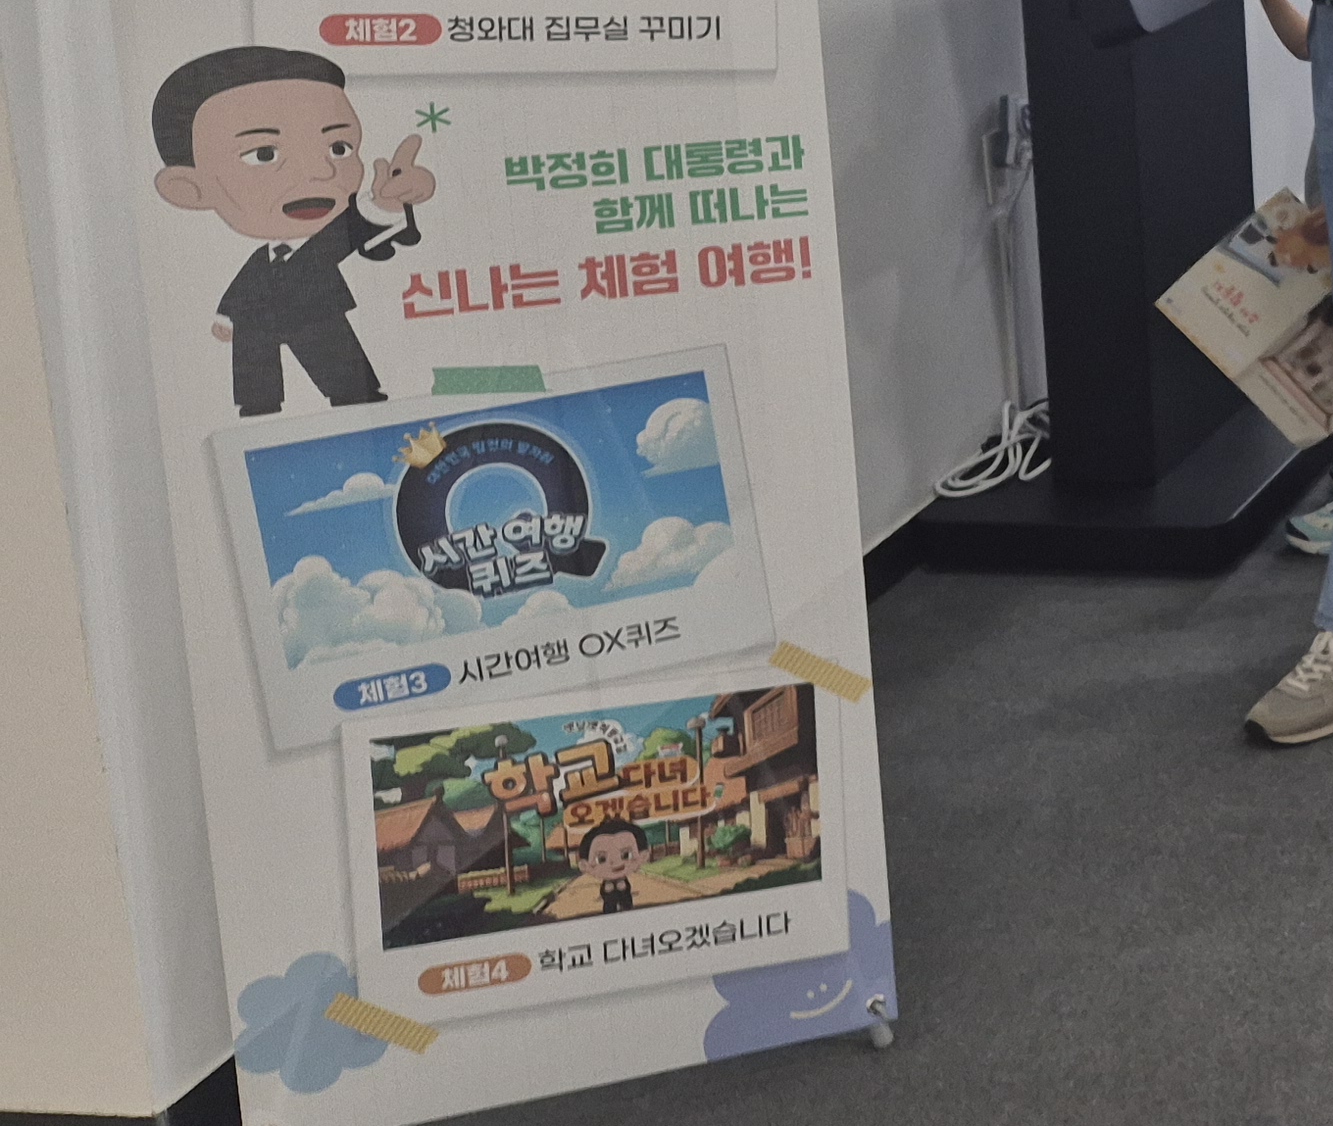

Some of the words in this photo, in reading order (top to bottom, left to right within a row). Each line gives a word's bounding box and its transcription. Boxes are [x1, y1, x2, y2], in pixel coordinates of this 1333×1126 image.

[345, 17, 418, 43] 체험2
[447, 15, 535, 43] 청와대
[544, 15, 630, 42] 집무실
[638, 16, 722, 42] 꾸미기
[504, 147, 630, 191] 박정희
[643, 134, 805, 182] 대통령과
[593, 192, 676, 235] 함께
[689, 183, 810, 226] 떠나는
[402, 262, 562, 320] 신나는
[578, 249, 680, 301] 체험
[698, 235, 812, 289] 여행!
[419, 522, 498, 574] 시간
[501, 514, 588, 554] 여행
[468, 550, 554, 597] 퀴즈
[357, 670, 428, 705] 체험3
[457, 638, 571, 685] 시간여행
[578, 616, 682, 658] OX퀴즈
[482, 738, 620, 816] 학교
[621, 756, 689, 788] 다녀
[569, 784, 713, 826] 오겠습니다
[441, 958, 509, 991] 체험4
[538, 943, 594, 973] 학교
[602, 910, 792, 964] 다녀오겠습니다
